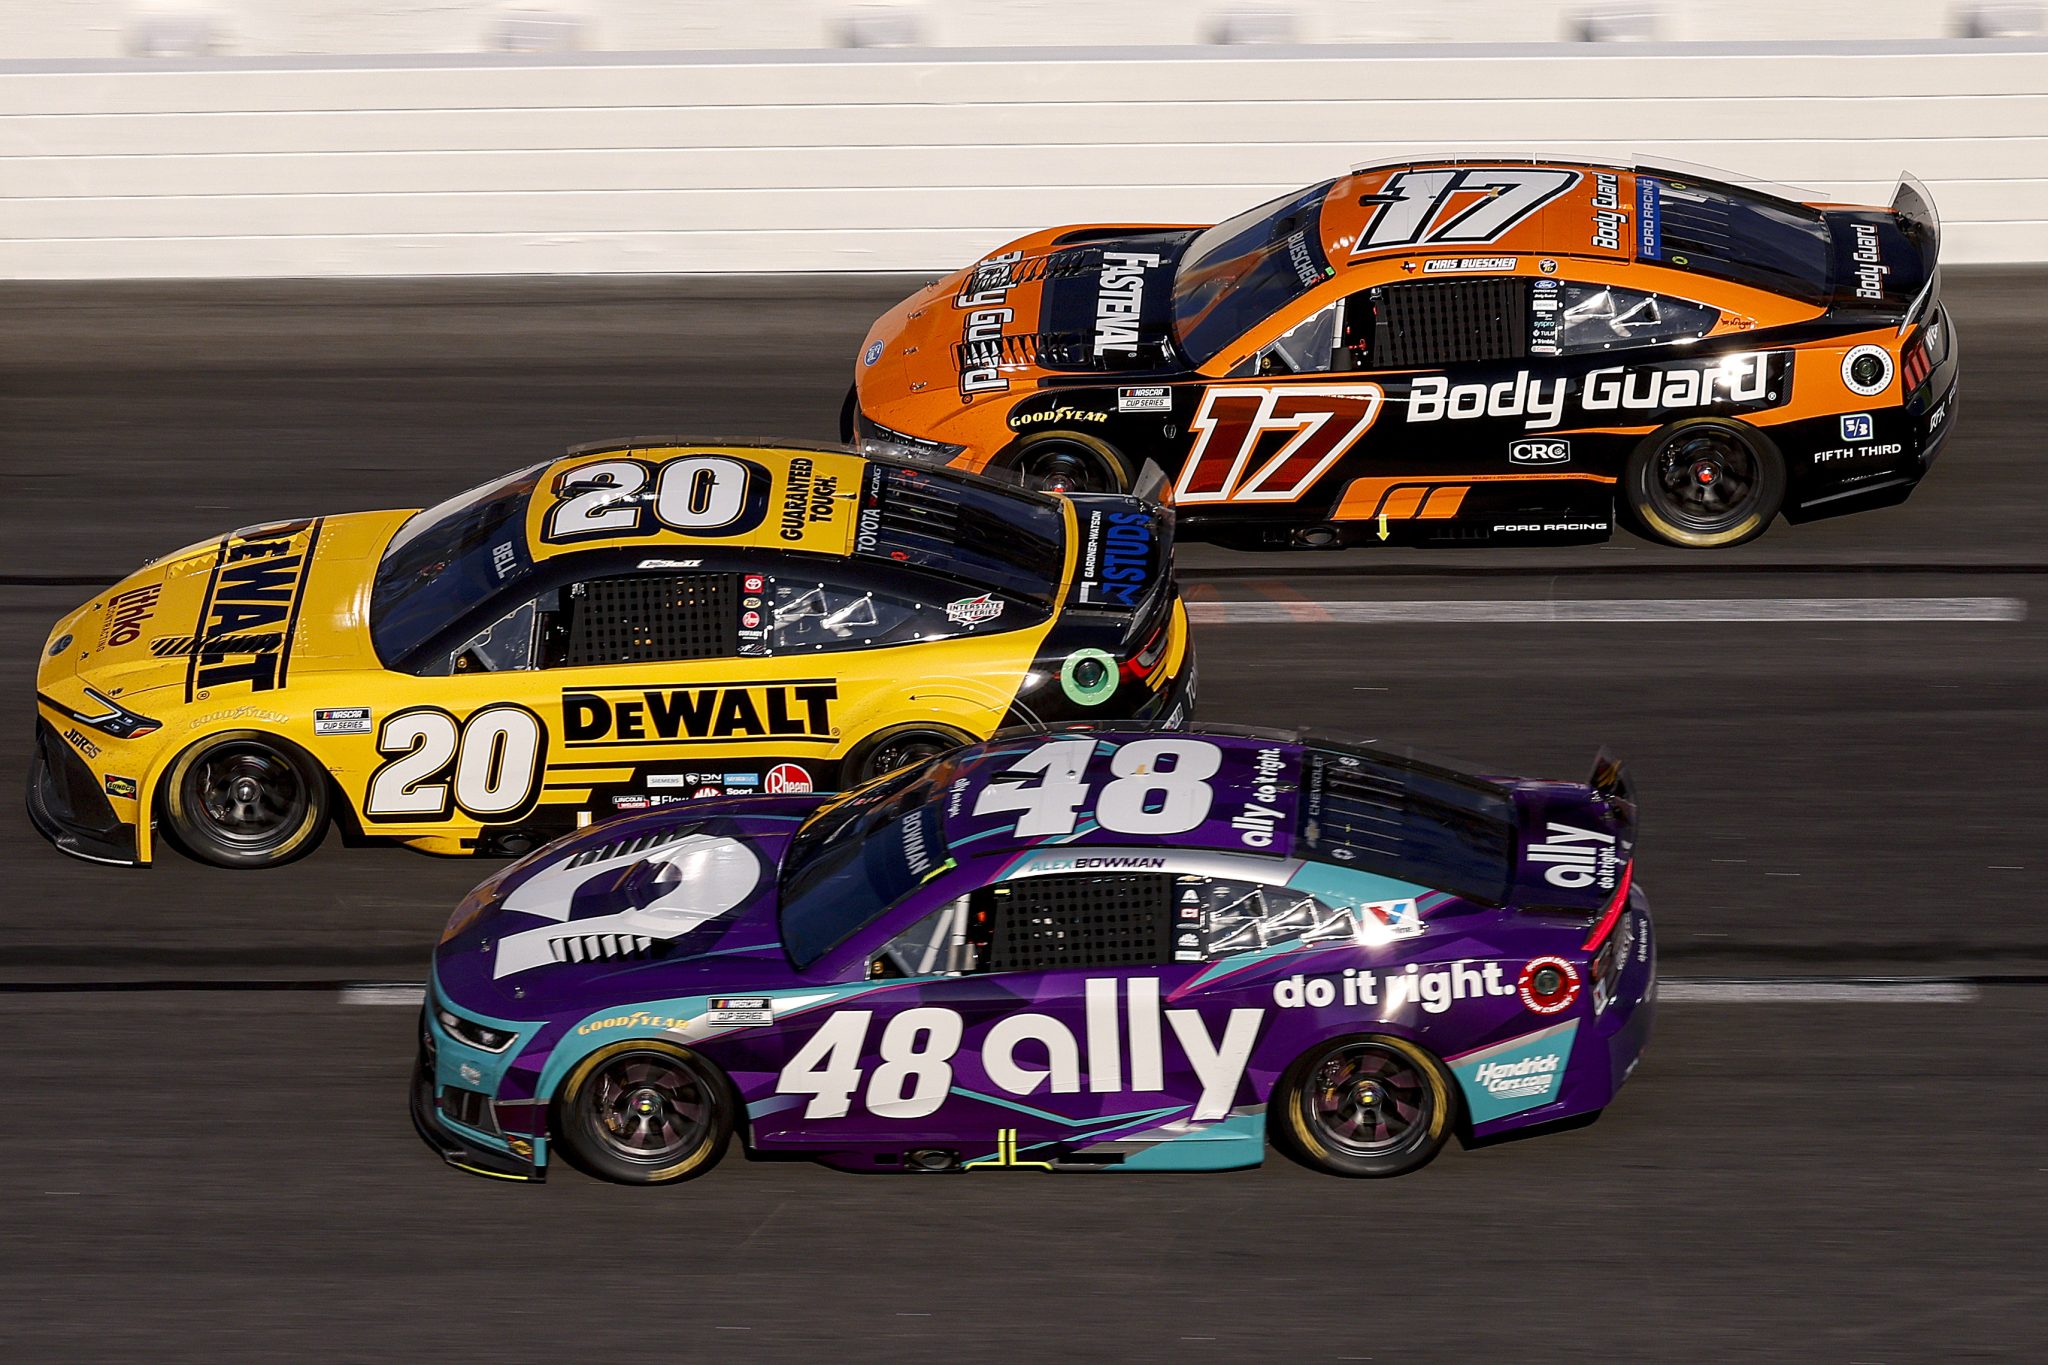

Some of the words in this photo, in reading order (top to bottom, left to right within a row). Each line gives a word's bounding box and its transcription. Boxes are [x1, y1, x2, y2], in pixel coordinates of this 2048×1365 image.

[1591, 171, 1619, 209] Guard
[1642, 179, 1654, 219] RACING
[1352, 169, 1583, 254] 17
[1591, 210, 1627, 250] Body
[1643, 219, 1655, 257] FORD
[1850, 223, 1879, 263] Guard
[1287, 230, 1319, 287] BUESCHER
[1424, 259, 1459, 271] CHRIS
[1460, 257, 1517, 270] BUESCHER
[1853, 263, 1889, 300] Body
[1092, 250, 1161, 359] FASTENAL
[1125, 399, 1140, 407] CUP
[1140, 398, 1165, 407] SERIES
[1133, 387, 1164, 397] NASCAR
[1405, 372, 1566, 430] Body
[1580, 352, 1771, 412] Guard
[1009, 406, 1108, 428] GOODYEAR
[1175, 383, 1384, 503] 17
[1513, 443, 1566, 460] CRC
[1813, 447, 1854, 463] FIFTH
[1858, 444, 1902, 458] THIRD
[549, 453, 752, 538] 20
[779, 457, 813, 541] GUARANTEED
[857, 508, 881, 551] TOYOTA
[1083, 510, 1102, 578] GARDNER-WATSON
[1493, 523, 1541, 532] FORD
[1543, 522, 1608, 532] RACING
[492, 540, 518, 580] BELL
[950, 602, 1002, 612] INTERSTATE
[322, 721, 338, 730] CUP
[337, 720, 363, 729] SERIES
[332, 710, 363, 719] NASCAR
[365, 704, 546, 823] 20
[1251, 776, 1278, 784] it
[1252, 747, 1287, 776] right.
[770, 771, 810, 794] Rheem
[973, 738, 1223, 837] 48
[1252, 784, 1277, 803] do
[902, 810, 931, 876] BOWMAN
[1231, 803, 1286, 848] ally
[1526, 821, 1616, 888] ally
[1273, 973, 1337, 1009] do
[1343, 969, 1379, 1009] it
[1383, 960, 1517, 1015] right.
[577, 1011, 689, 1036] GOODYEAR
[717, 1011, 734, 1021] CUP
[735, 1011, 764, 1020] SERIES
[775, 1006, 963, 1121] 48
[981, 977, 1265, 1121] ally
[1475, 1053, 1560, 1087] Hendrick
